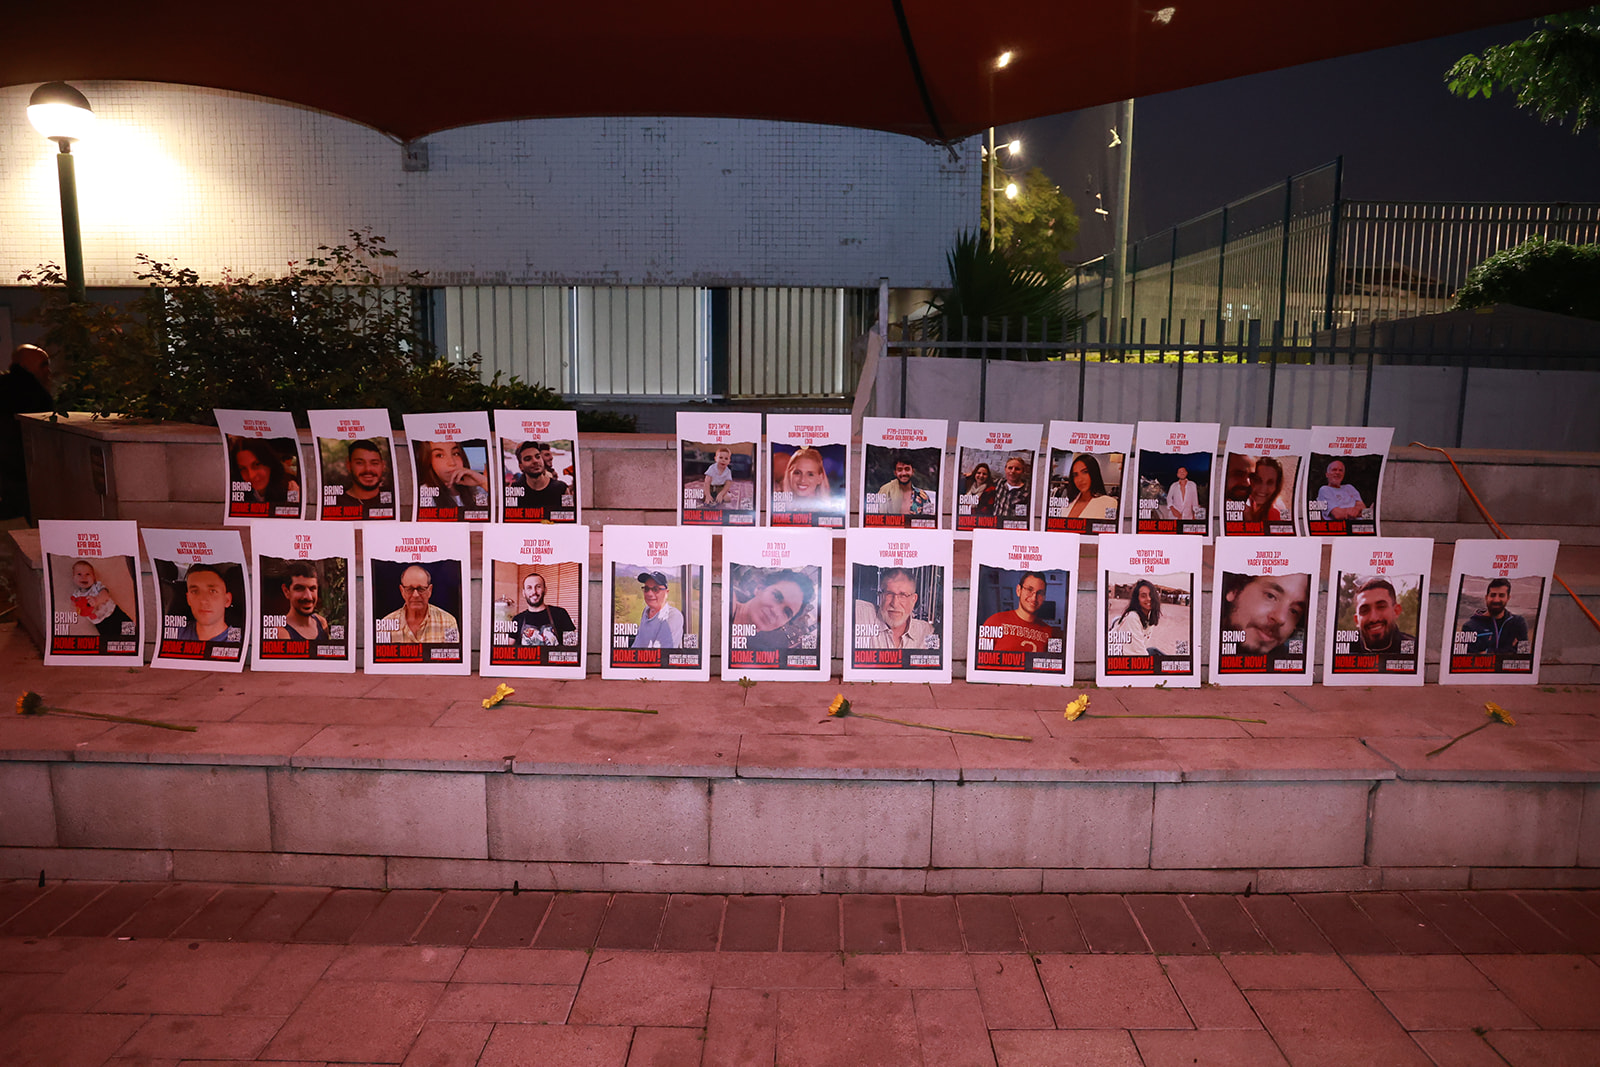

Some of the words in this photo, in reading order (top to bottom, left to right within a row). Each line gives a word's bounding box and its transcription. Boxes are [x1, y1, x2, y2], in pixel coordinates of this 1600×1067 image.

[232, 482, 251, 492] BRING
[324, 485, 344, 495] BRING
[420, 487, 439, 497] BRING
[505, 487, 525, 496] BRING
[232, 492, 244, 501] HER
[684, 489, 704, 499] BRING
[773, 492, 793, 502] BRING
[867, 494, 886, 503] BRING
[959, 495, 979, 504] BRING
[324, 496, 337, 505] HIM
[420, 497, 432, 507] HER
[505, 497, 518, 507] HIM
[684, 499, 697, 508] HIM
[1050, 497, 1069, 507] BRING
[1139, 499, 1158, 509] BRING
[1226, 501, 1245, 511] BRING
[1309, 501, 1327, 510] BRING
[773, 502, 786, 512] HER
[866, 504, 879, 513] HIM
[959, 505, 972, 514] HIM
[1049, 507, 1061, 516] HER
[1139, 510, 1150, 519] HIM
[1226, 511, 1243, 520] THEM
[1309, 511, 1321, 520] HIM
[55, 612, 78, 623] BRING
[165, 615, 187, 627] BRING
[264, 615, 287, 627] BRING
[55, 624, 69, 635] HIM
[376, 619, 400, 630] BRING
[494, 621, 517, 633] BRING
[614, 624, 638, 635] BRING
[164, 628, 178, 639] HIM
[264, 628, 278, 639] HER
[732, 625, 756, 636] BRING
[855, 625, 879, 636] BRING
[980, 626, 1003, 638] BRING
[1337, 631, 1359, 641] BRING
[376, 632, 391, 643] HIM
[494, 634, 509, 645] HIM
[614, 636, 629, 648] HIM
[1108, 632, 1132, 643] BRING
[1222, 631, 1246, 642] BRING
[1455, 632, 1478, 642] BRING
[54, 637, 75, 649] HOME
[77, 637, 99, 649] NOW!
[162, 641, 183, 652] HOME
[185, 642, 206, 654] NOW!
[263, 641, 285, 653] HOME
[287, 641, 309, 653] NOW!
[732, 637, 747, 649] HER
[855, 637, 870, 649] HIM
[979, 638, 994, 650] HIM
[1222, 643, 1237, 654] HIM
[1336, 643, 1350, 654] HIM
[376, 645, 398, 656] HOME
[400, 644, 423, 657] NOW!
[493, 647, 516, 659] HOME
[517, 646, 540, 659] NOW!
[1108, 644, 1122, 656] HER
[1454, 644, 1468, 654] HIM
[613, 650, 636, 662] HOME
[638, 649, 661, 662] NOW!
[731, 651, 754, 662] HOME
[756, 650, 779, 662] NOW!
[855, 651, 877, 662] HOME
[879, 650, 902, 663] NOW!
[978, 652, 1000, 664] HOME
[1002, 652, 1024, 665] NOW!
[1108, 658, 1130, 669] HOME
[1131, 656, 1154, 669] NOW!
[1222, 657, 1243, 667] HOME
[1244, 655, 1266, 668] NOW!
[1334, 656, 1356, 667] HOME
[1357, 655, 1379, 668] NOW!
